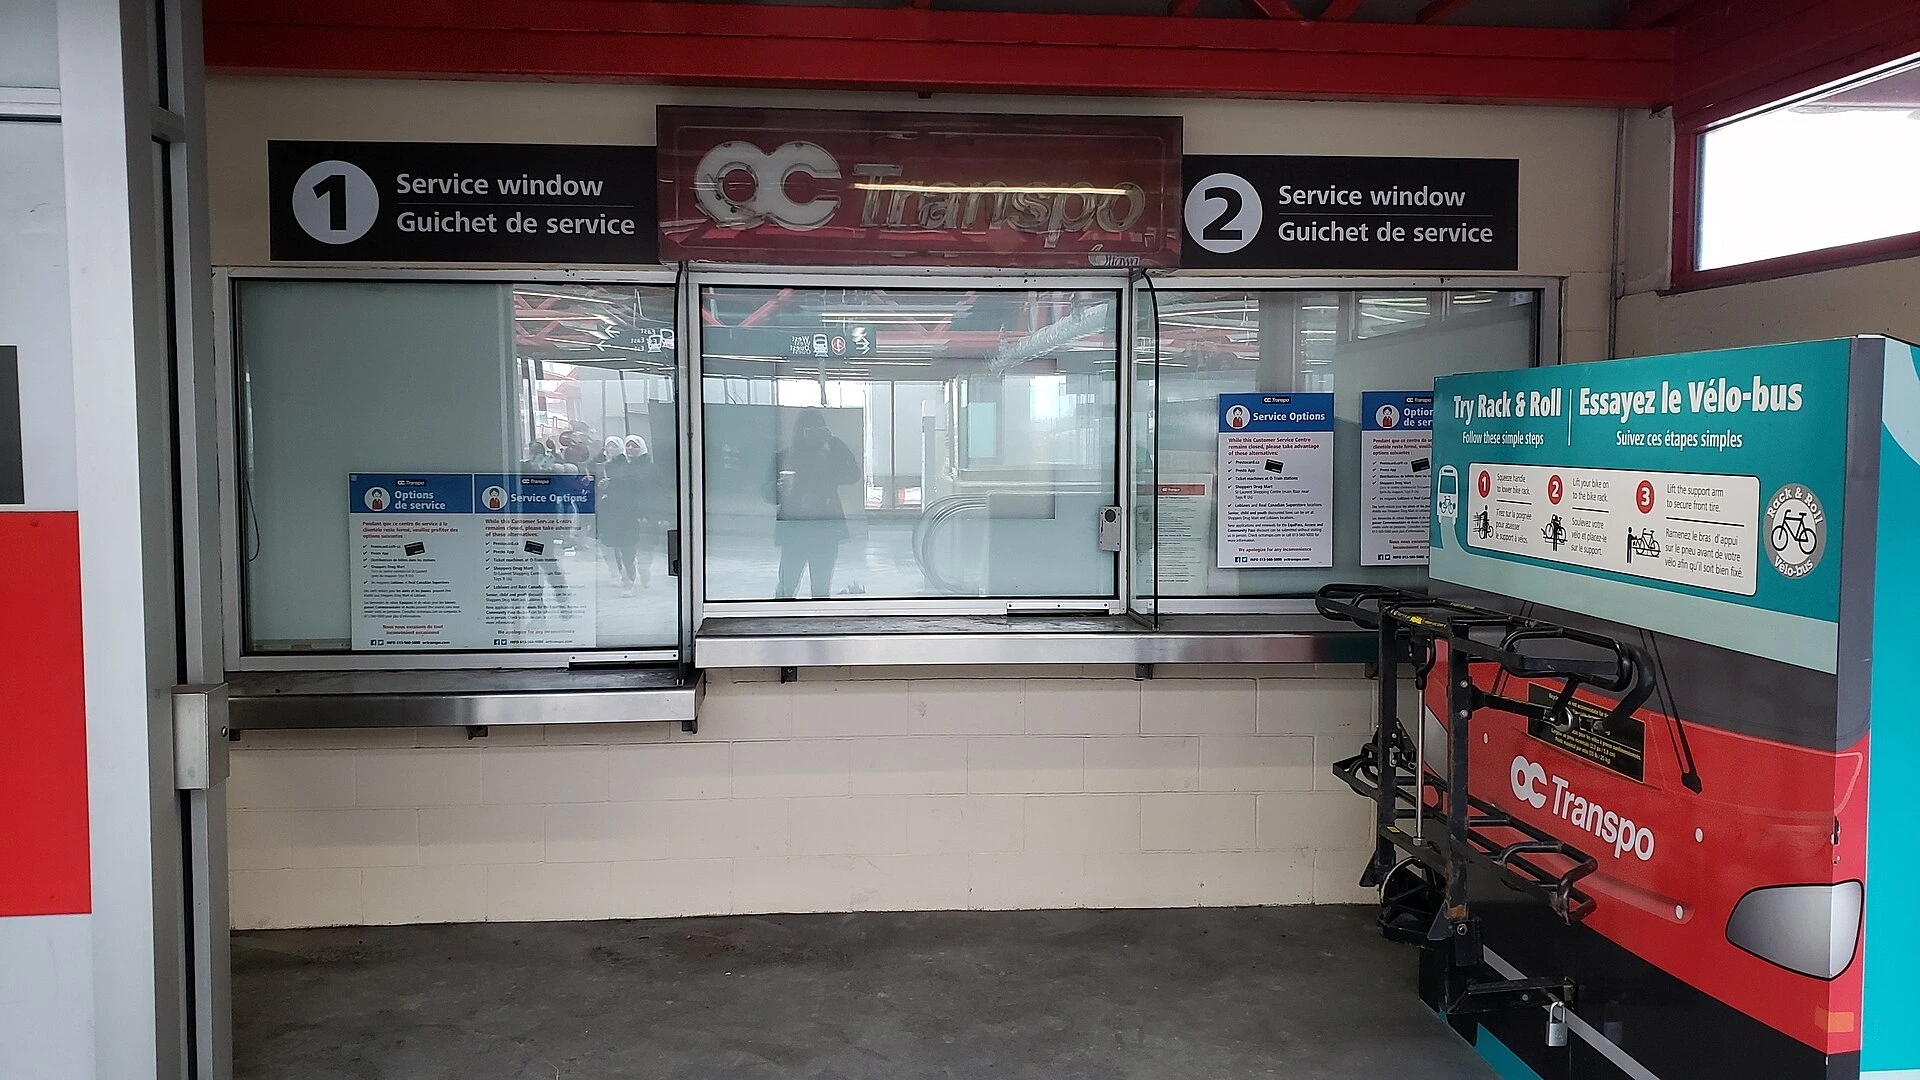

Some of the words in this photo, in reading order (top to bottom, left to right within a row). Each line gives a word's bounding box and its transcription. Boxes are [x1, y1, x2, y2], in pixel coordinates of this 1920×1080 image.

[397, 173, 489, 195] Service
[497, 175, 605, 196] window
[312, 173, 347, 231] 1
[696, 140, 843, 232] OC
[852, 163, 1146, 249] Transpo
[1279, 185, 1362, 206] Service
[1370, 187, 1466, 207] window
[1202, 186, 1244, 241] 2
[397, 219, 498, 241] Guichet
[507, 221, 538, 242] de
[546, 224, 636, 244] service
[1278, 221, 1370, 242] Guichet
[1376, 222, 1406, 243] de
[1413, 225, 1494, 244] service
[1453, 395, 1474, 425] Try
[1477, 391, 1511, 418] Rack
[1515, 391, 1526, 418] &
[1530, 388, 1562, 417] Roll
[1579, 388, 1656, 424] Essayez
[1661, 380, 1682, 415] le
[1688, 375, 1803, 414] Vélo-bus
[1253, 412, 1287, 421] Service
[1289, 412, 1326, 422] Options
[1404, 408, 1433, 419] Optio
[1404, 418, 1415, 427] de
[1462, 431, 1482, 444] Follow
[1483, 431, 1500, 445] these
[1501, 431, 1524, 448] simple
[1525, 432, 1544, 449] steps
[1616, 429, 1645, 447] Suivez
[1647, 434, 1662, 447] ces
[1665, 430, 1698, 451] étapes
[1701, 429, 1743, 452] simples
[1481, 476, 1487, 492] 1
[1552, 481, 1559, 498] 2
[1580, 480, 1591, 489] your
[1591, 480, 1602, 488] bike
[1667, 484, 1676, 493] Lift
[1677, 485, 1686, 495] the
[1688, 487, 1710, 498] support
[1711, 489, 1724, 498] arm
[394, 490, 434, 501] Options
[394, 500, 407, 510] de
[410, 500, 446, 510] service
[510, 493, 547, 502] Service
[549, 493, 588, 504] Options
[1586, 492, 1597, 501] bike
[1641, 487, 1650, 506] 3
[1667, 499, 1673, 508] to
[1674, 501, 1692, 510] secure
[1693, 500, 1708, 511] front
[1709, 503, 1721, 513] tire.
[1767, 488, 1792, 518] Rack
[1795, 487, 1803, 499] &
[1804, 493, 1823, 525] Roll
[1571, 517, 1591, 528] Soulevez
[1591, 520, 1604, 530] votre
[1666, 528, 1691, 541] Ramenez
[1692, 531, 1697, 541] le
[1699, 532, 1711, 543] bras
[1714, 533, 1739, 547] d'appui
[1665, 544, 1674, 552] sur
[1675, 543, 1680, 553] le
[1681, 545, 1696, 557] pneu
[1697, 547, 1714, 558] avant
[1715, 549, 1722, 560] de
[1724, 552, 1741, 562] votre
[1665, 557, 1676, 568] vélo
[1677, 558, 1688, 570] afin
[1690, 561, 1702, 573] qu'il
[1703, 563, 1714, 573] soit
[1715, 565, 1729, 576] bien
[1730, 566, 1744, 578] fixé.
[1774, 555, 1814, 577] Vélo-bus
[1511, 755, 1547, 809] OC
[1552, 775, 1655, 861] Transpo
